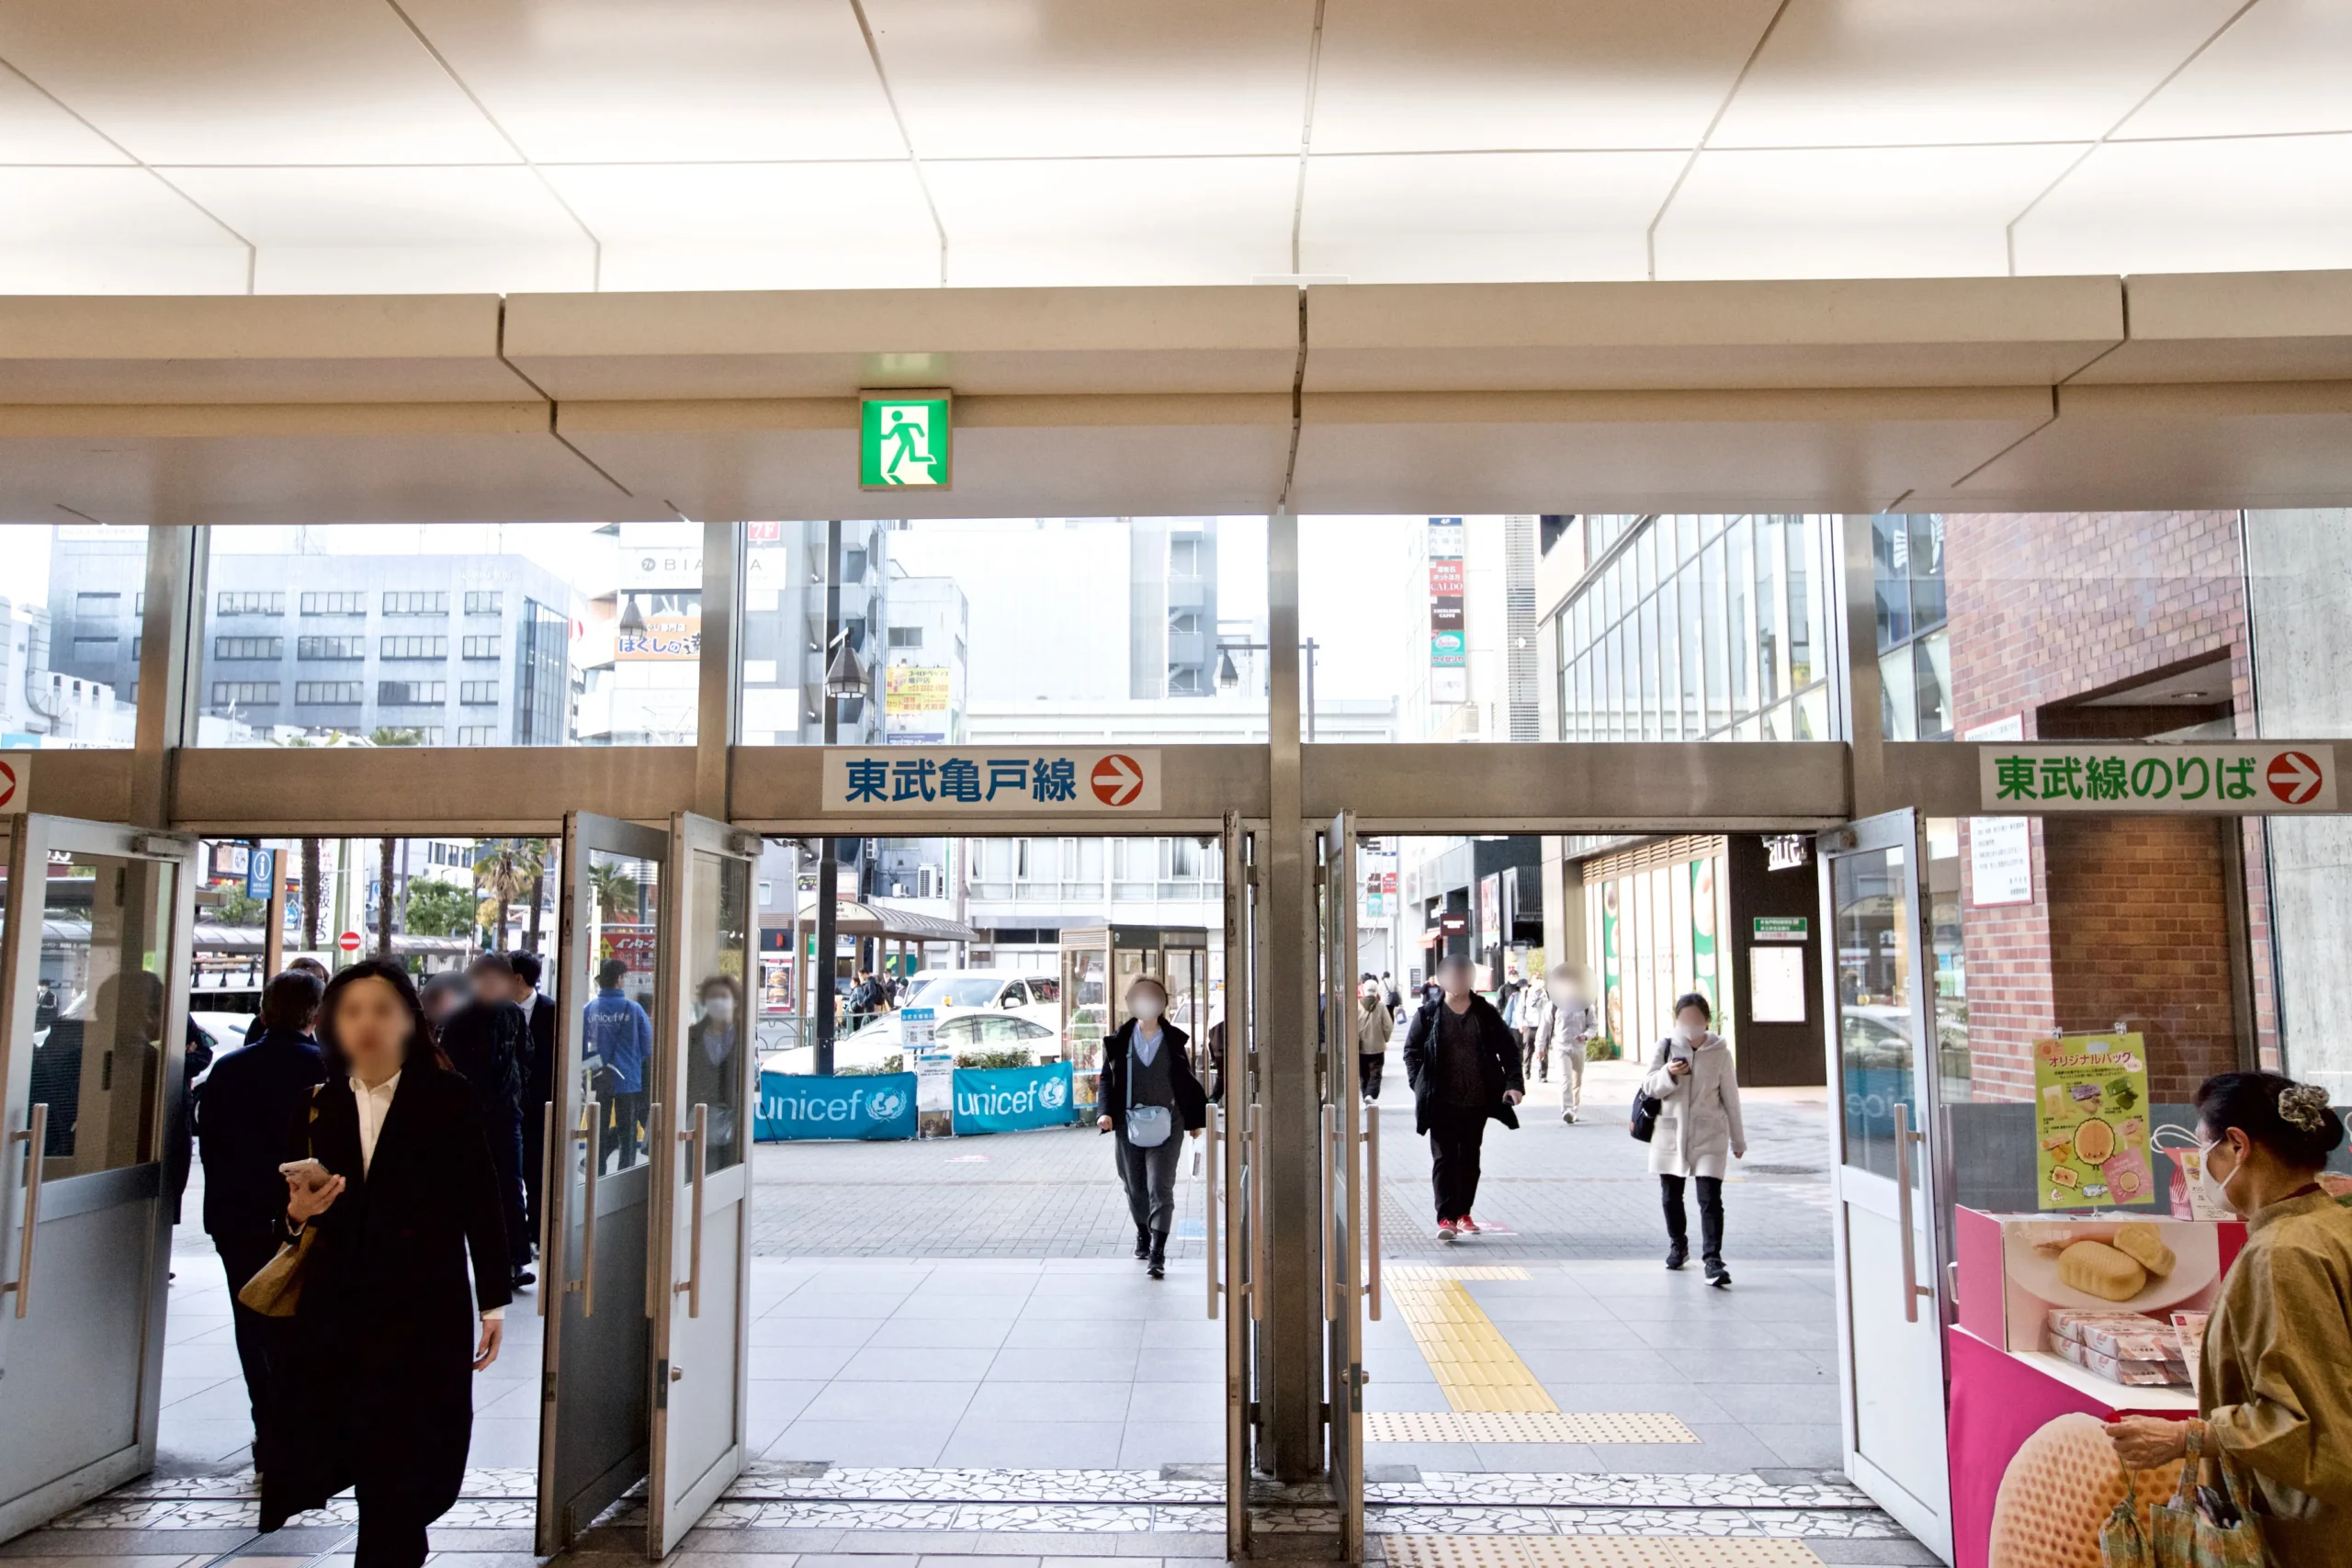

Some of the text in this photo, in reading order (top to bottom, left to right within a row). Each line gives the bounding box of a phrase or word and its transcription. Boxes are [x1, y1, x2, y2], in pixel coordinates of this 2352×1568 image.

[752, 522, 776, 537] 7F
[1430, 582, 1464, 591] CALDO
[845, 758, 1077, 802] 東武亀戸線
[1995, 755, 2257, 800] 東武線のりば
[588, 1011, 618, 1023] unicef
[2049, 1051, 2132, 1067] オリジナルバッグ
[754, 1089, 864, 1122] unicef
[957, 1080, 1038, 1116] unicef
